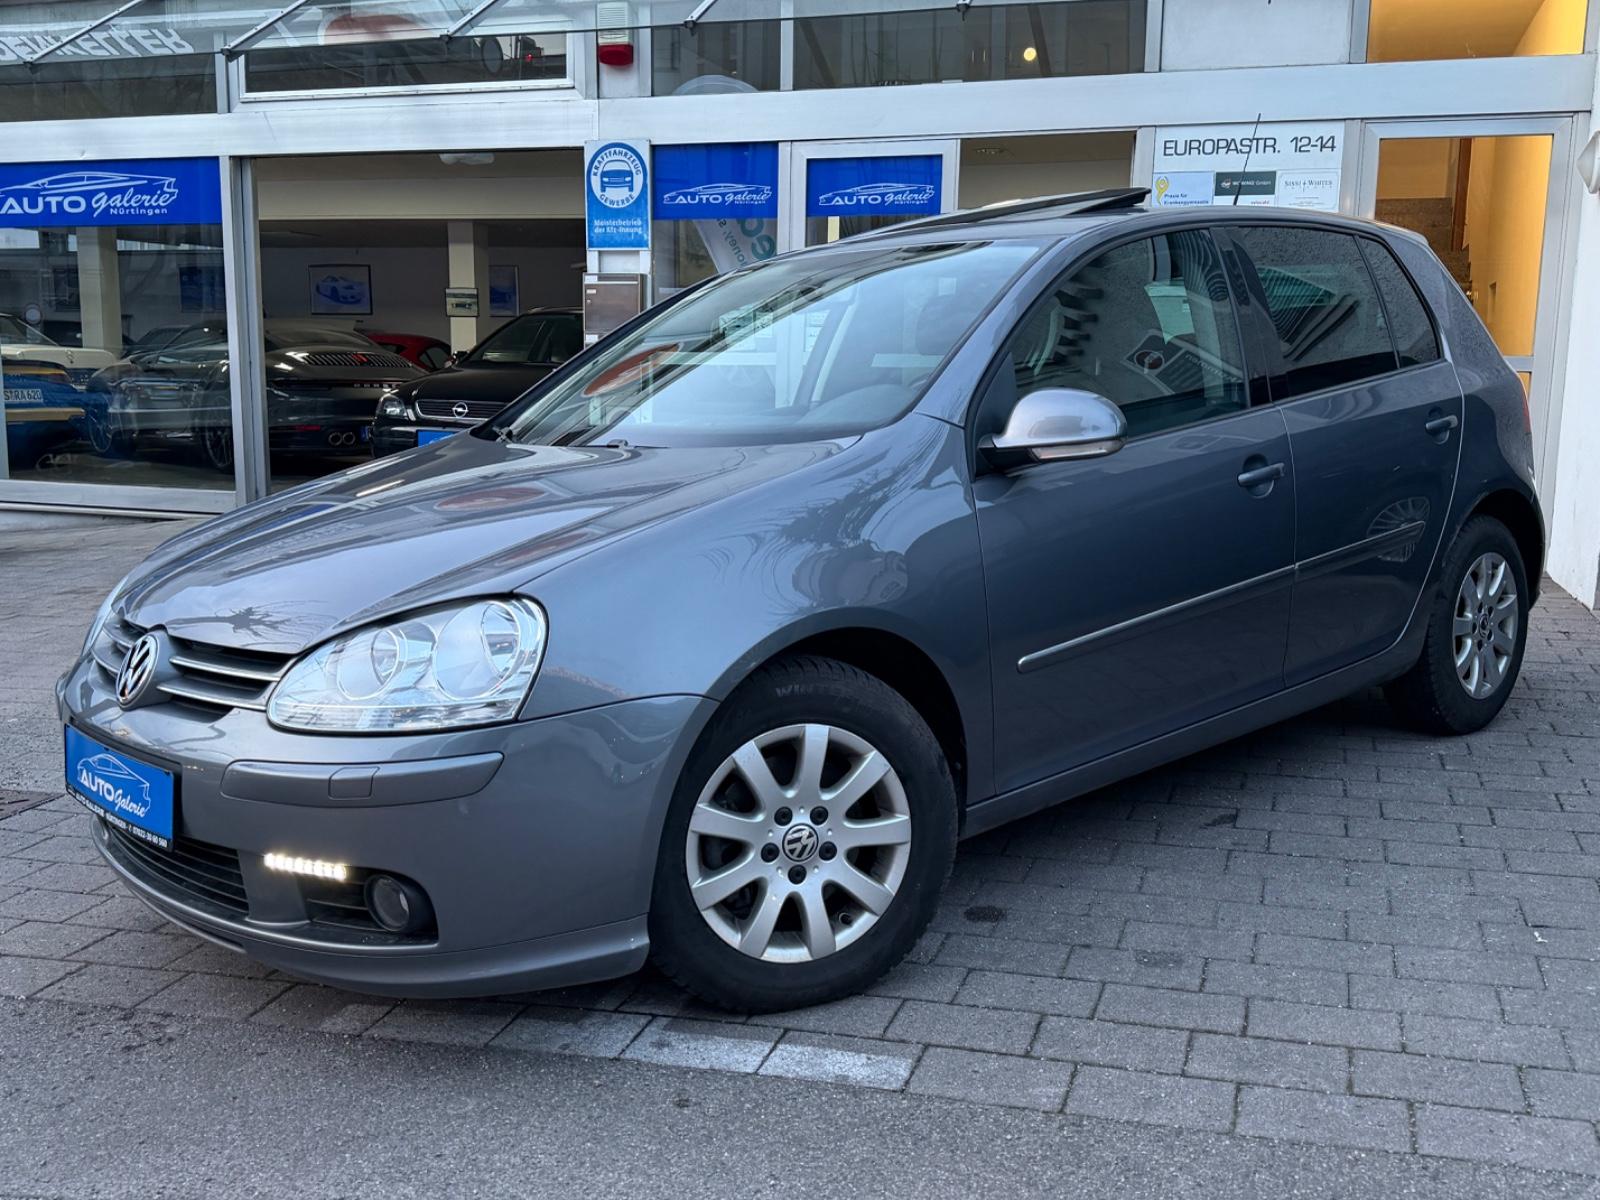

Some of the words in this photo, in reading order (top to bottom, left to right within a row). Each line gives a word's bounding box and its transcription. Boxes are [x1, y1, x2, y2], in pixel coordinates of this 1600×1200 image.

[1162, 136, 1281, 157] EUROPASTR.
[1289, 135, 1337, 154] 12-14
[592, 148, 642, 177] KRAFTFAHRZEUG
[0, 195, 87, 215] AUTO
[599, 193, 635, 207] GEWERBE
[675, 194, 723, 204] AUTO
[831, 195, 881, 205] AUTO
[109, 206, 168, 216] Nürtingen
[593, 218, 642, 227] Meisterbetrieb
[80, 769, 116, 802] AUTO
